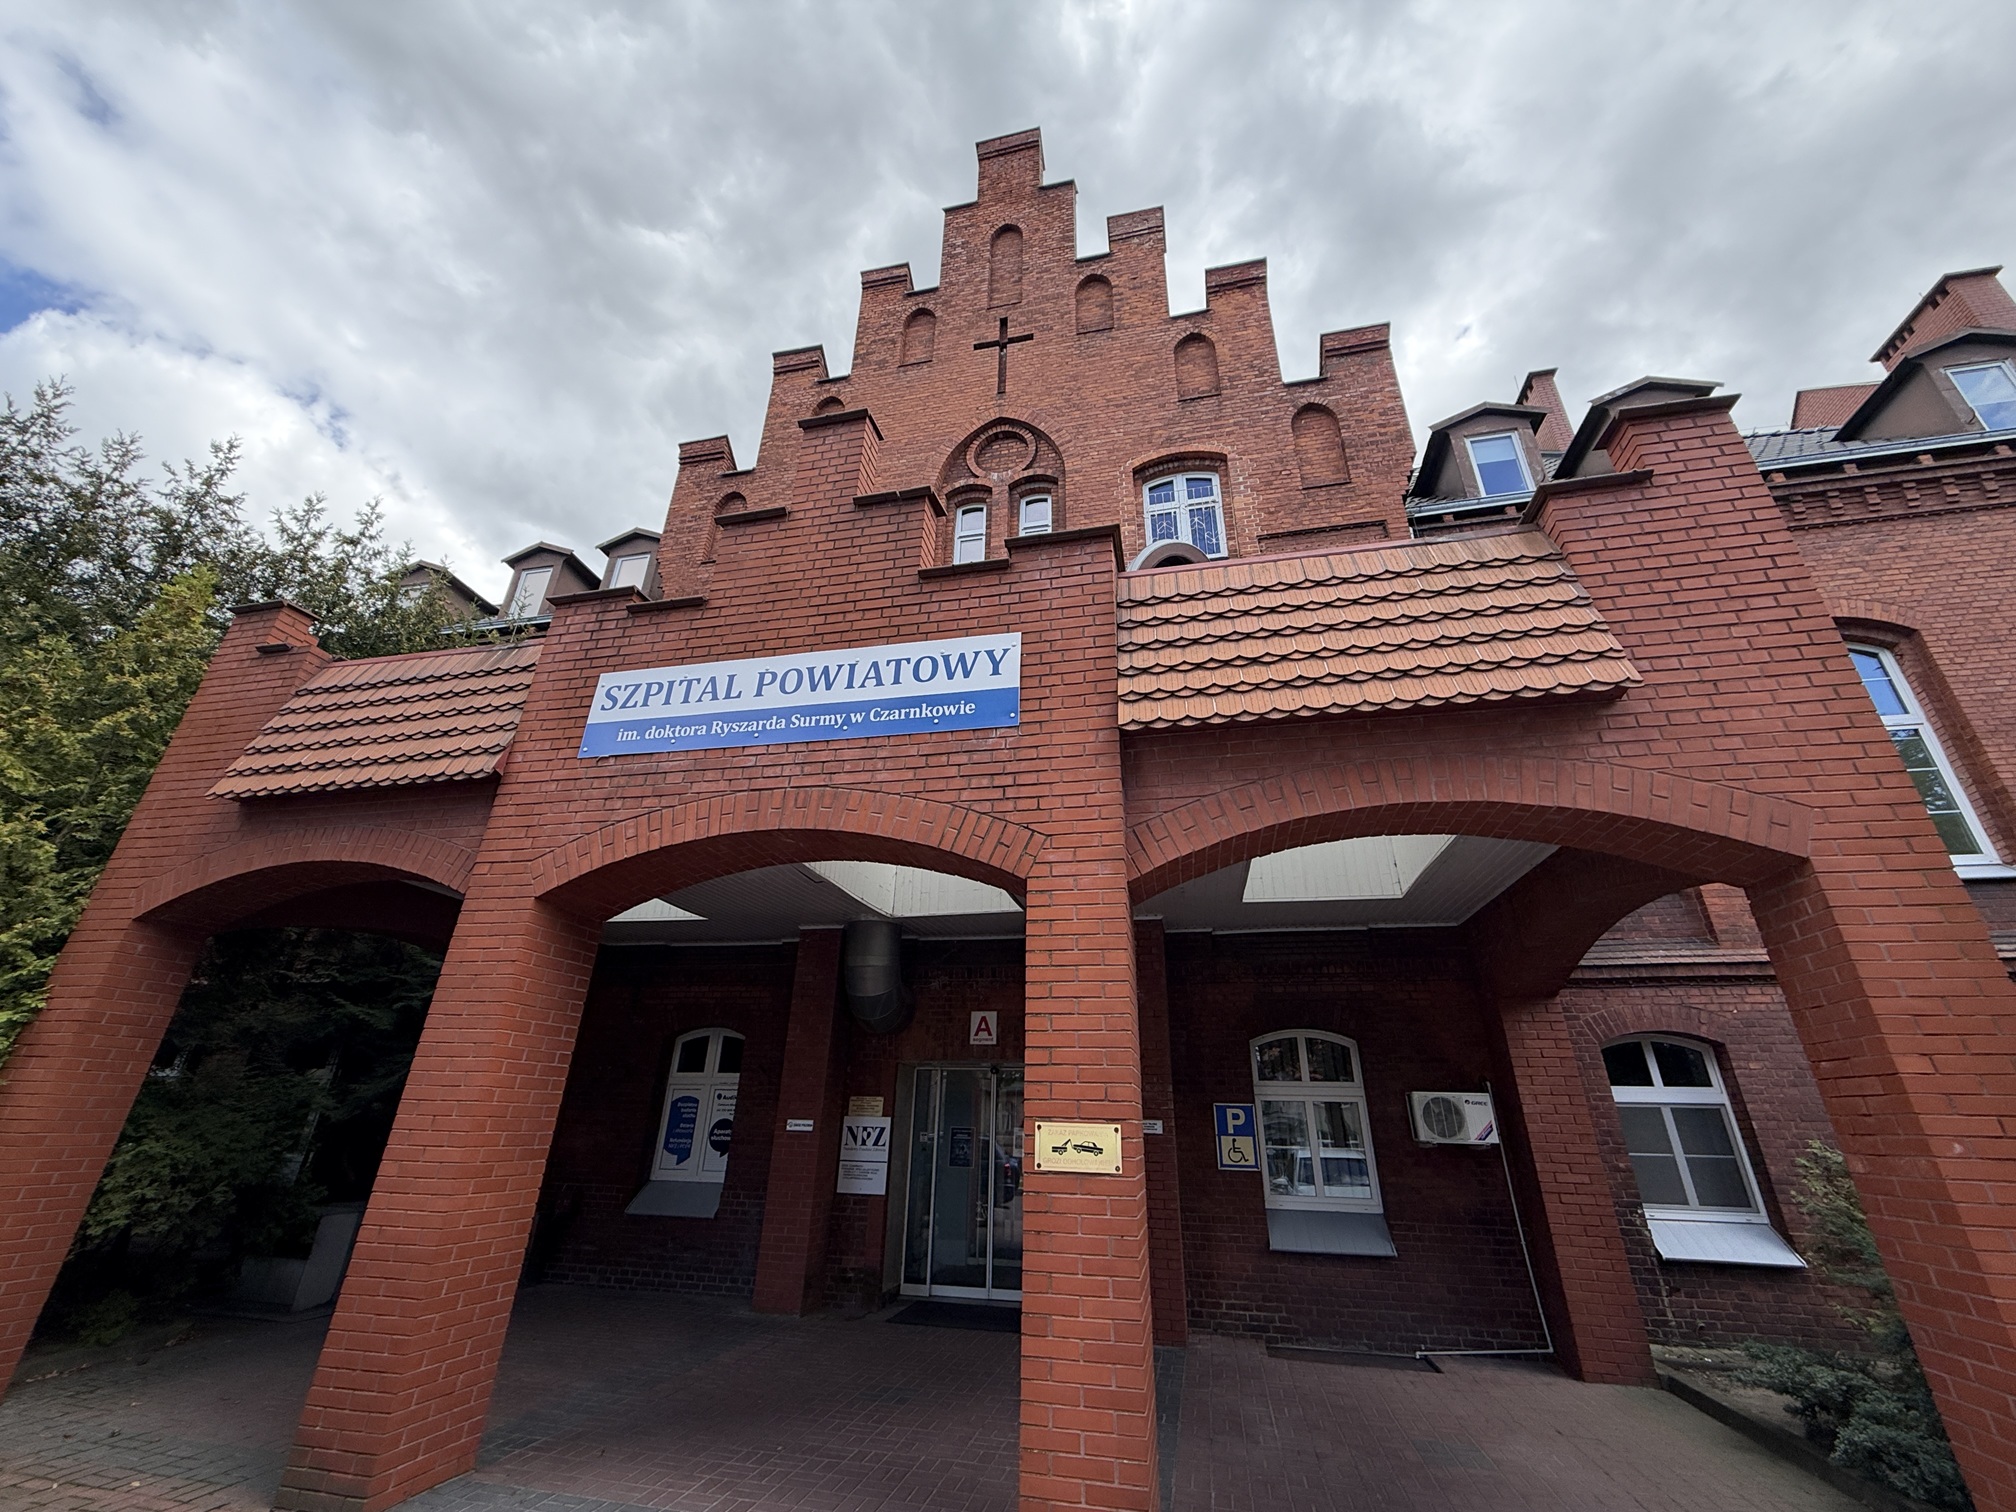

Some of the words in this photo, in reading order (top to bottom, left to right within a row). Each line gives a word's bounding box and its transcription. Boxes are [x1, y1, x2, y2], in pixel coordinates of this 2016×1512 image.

[600, 674, 742, 711] SZPITAL
[753, 647, 1011, 698] POWIATOWY
[616, 728, 641, 742] im.
[645, 724, 706, 740] doktora
[710, 715, 786, 739] Ryszarda
[790, 712, 846, 729] Surmy
[850, 711, 866, 724] w
[869, 700, 976, 722] Czarnkowie
[973, 1016, 993, 1037] A
[1226, 1108, 1246, 1134] P
[844, 1125, 887, 1147] NFZ
